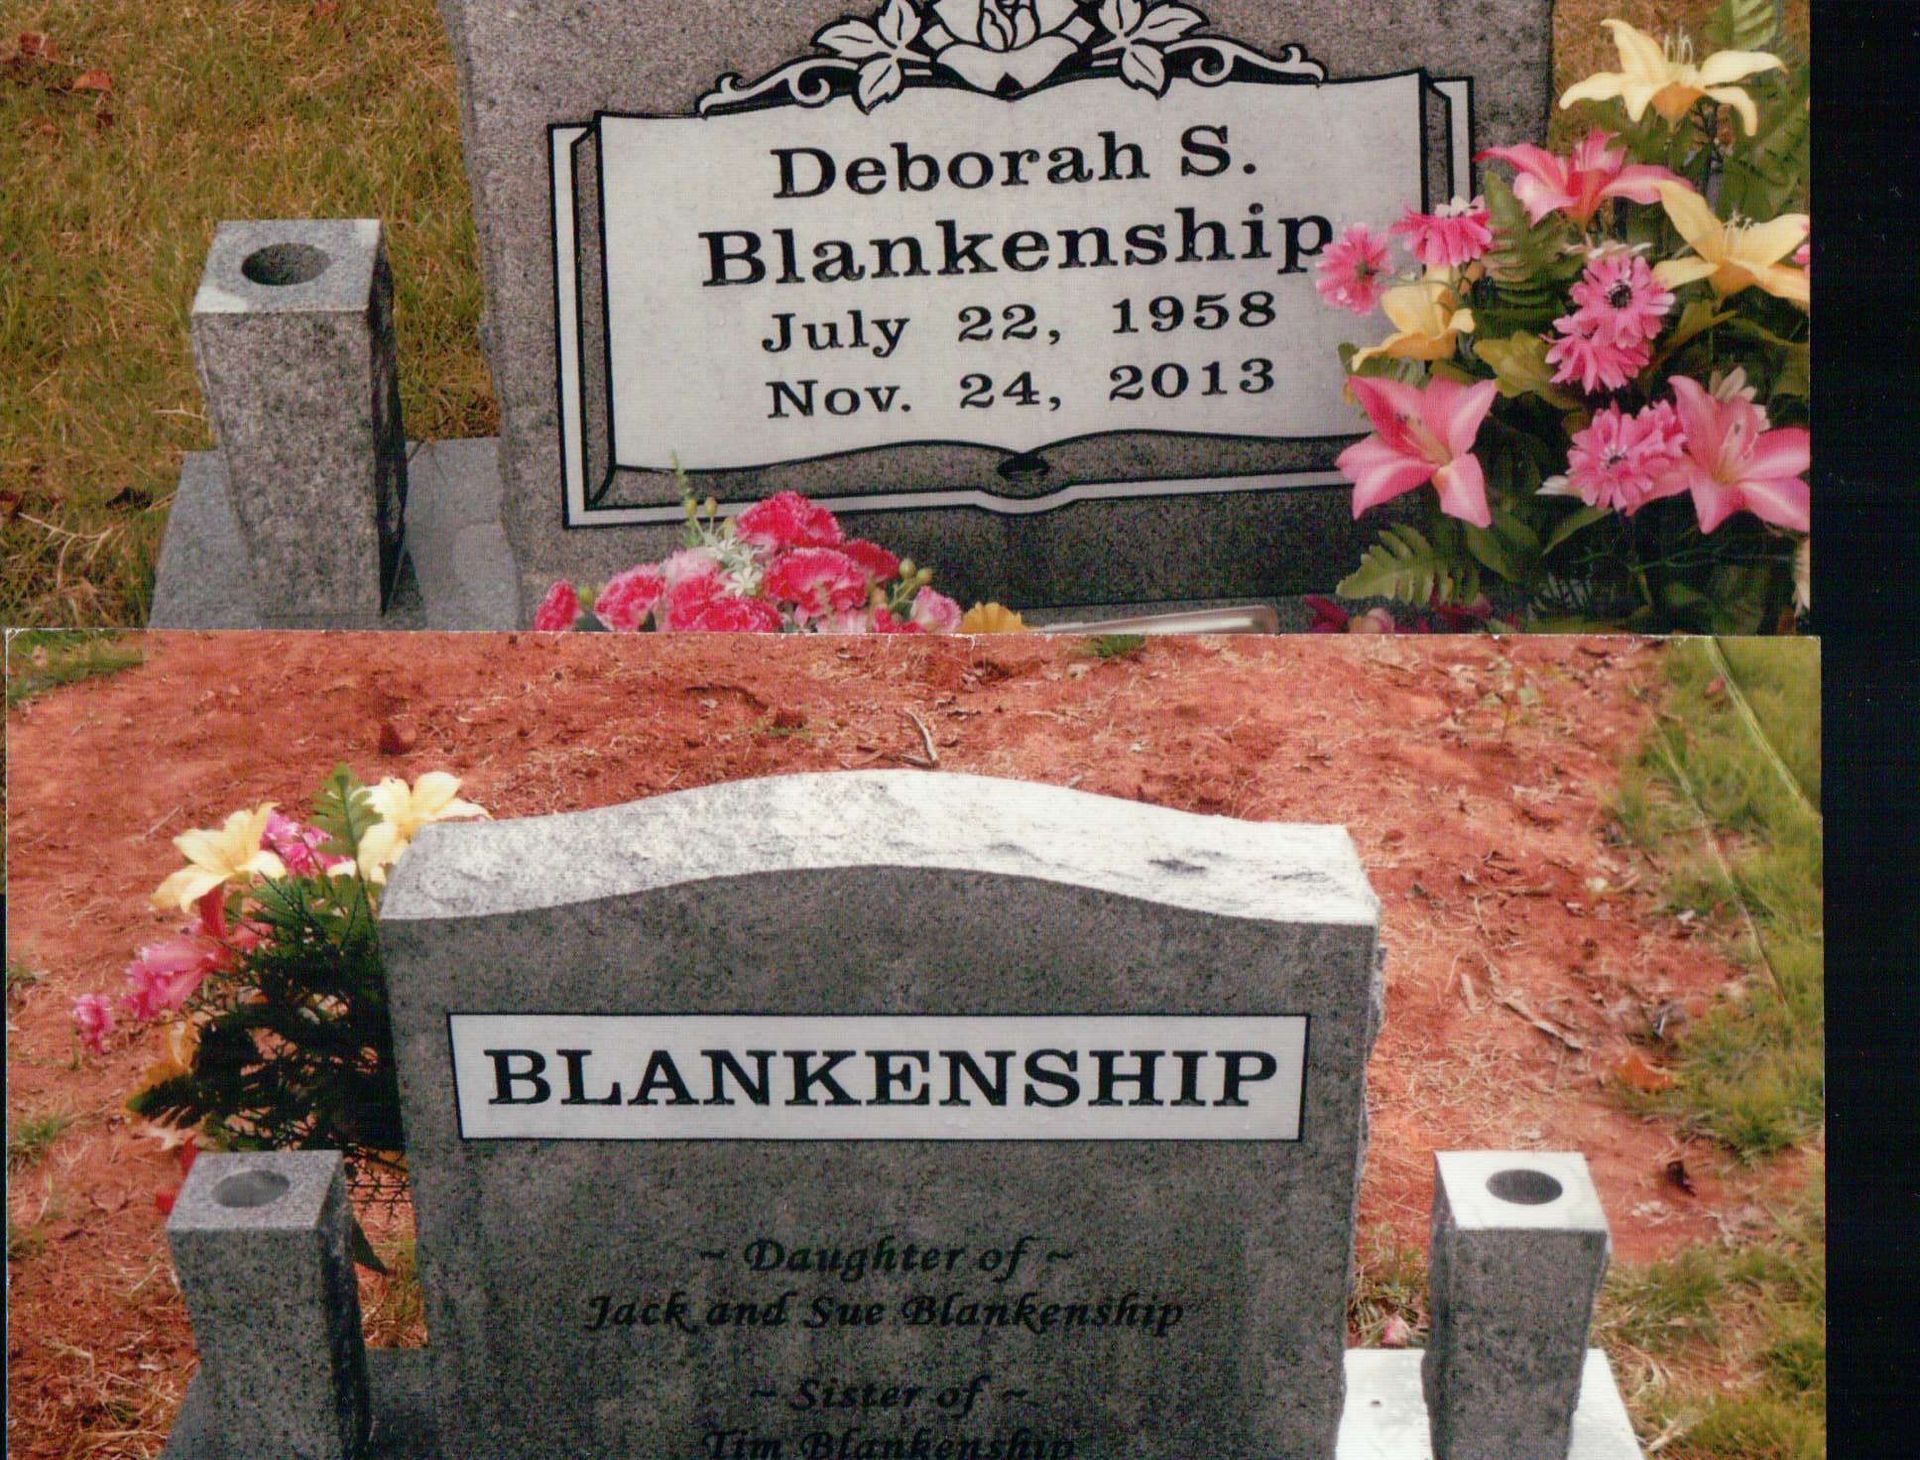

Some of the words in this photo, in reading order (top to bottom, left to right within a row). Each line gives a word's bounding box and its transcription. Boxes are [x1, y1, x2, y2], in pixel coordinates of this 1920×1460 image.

[771, 131, 1149, 200] Deborah
[1180, 123, 1257, 178] S.
[699, 201, 1335, 287] Blankenship
[761, 311, 911, 358] July
[957, 303, 1062, 345] 22,
[1111, 291, 1278, 335] 1958
[766, 380, 912, 420] Nov.
[959, 369, 1063, 411] 24,
[1109, 358, 1276, 400] 2013
[483, 1049, 1278, 1107] BLANKENSHIP
[744, 1237, 962, 1283] Daughter
[977, 1237, 1029, 1282] of
[584, 1294, 698, 1332] Jack
[706, 1293, 786, 1328] and
[804, 1296, 884, 1328] Sue
[901, 1291, 1185, 1338] Blankenship
[790, 1377, 920, 1411] Sister
[937, 1374, 991, 1418] of
[701, 1428, 782, 1460] Tim
[800, 1427, 1076, 1460] Blankenship
